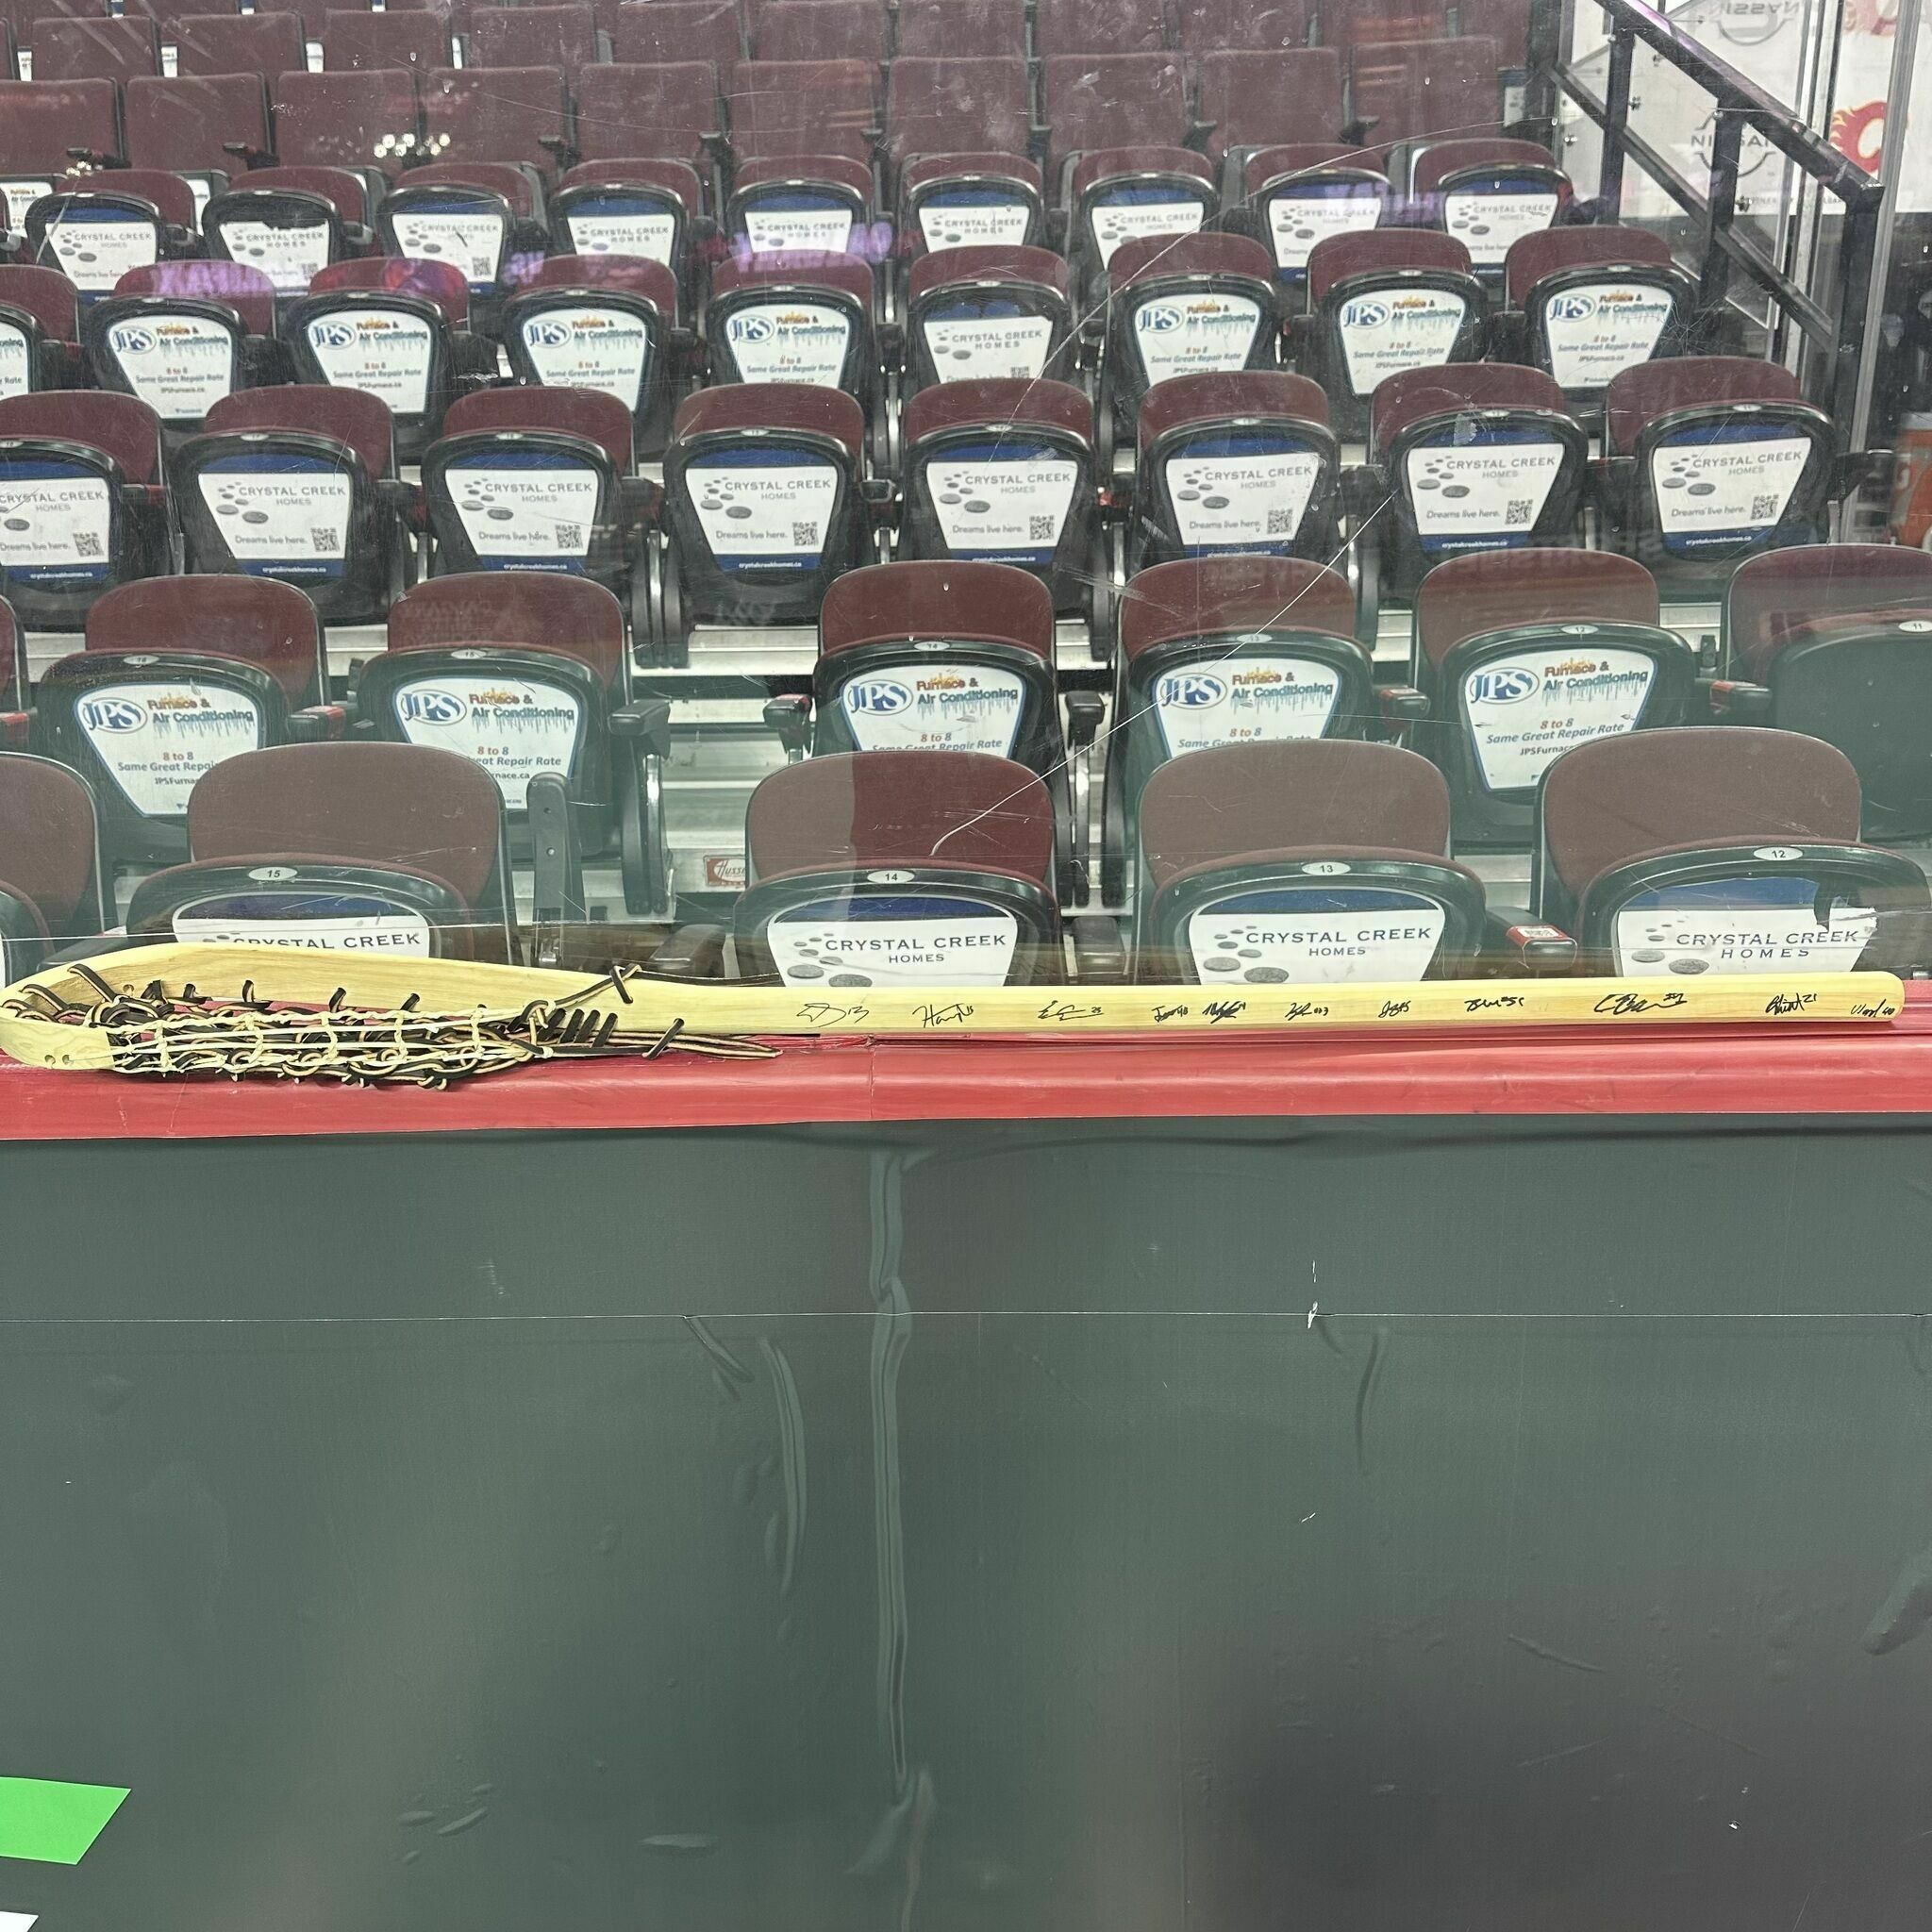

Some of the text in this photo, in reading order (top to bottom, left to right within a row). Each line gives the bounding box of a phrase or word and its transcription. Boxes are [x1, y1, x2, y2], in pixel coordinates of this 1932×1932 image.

[1549, 299, 1591, 321] JPS
[1140, 308, 1180, 331] JPS
[731, 318, 773, 341] JPS
[952, 330, 1041, 342] CRYSTAL CREEK
[975, 341, 1020, 349] HOMES
[1447, 458, 1555, 469] CRYSTAL CREEK
[1692, 451, 1801, 468] CRYSTAL CREEK
[1206, 467, 1311, 480] CRYSTAL CREEK
[1728, 466, 1764, 475] HOMES
[724, 479, 830, 491] CRYSTAL CREEK
[965, 474, 1070, 484] CRYSTAL CREEK
[1241, 480, 1275, 489] HOMES
[239, 487, 345, 495] CRYSTAL CREEK
[485, 483, 591, 492] CRYSTAL CREEK
[0, 491, 104, 505] CRYSTAL CREEK
[1426, 510, 1459, 519] Dreams
[1672, 508, 1707, 517] Dreams
[1190, 521, 1222, 529] Dreams
[478, 531, 511, 540] Dreams
[716, 530, 748, 539] Dreams
[1544, 661, 1609, 677] Furnace &
[916, 678, 978, 691] Furnace &
[1232, 673, 1294, 685] Furnace &
[1543, 671, 1648, 691] Air Conditioning
[1162, 677, 1220, 707] JPS
[1232, 683, 1333, 699] Air Conditioning
[1471, 674, 1533, 704] JPS
[470, 693, 533, 705] Furnace &
[851, 684, 907, 713] JPS
[918, 689, 1018, 705] Air Conditioning
[147, 699, 210, 709] Furnace &
[401, 692, 460, 721] JPS
[81, 700, 142, 730] JPS
[153, 709, 254, 724] Air Conditioning
[472, 707, 574, 720] Air Conditioning
[1541, 721, 1548, 729] 8
[1566, 718, 1574, 726] 8
[1230, 728, 1237, 737] 8
[1254, 727, 1261, 736] 8
[1487, 724, 1624, 743] Same Great Repair Rate
[977, 740, 1002, 748] Rate
[1178, 739, 1209, 748] Same
[188, 752, 193, 760] 8
[478, 746, 484, 755] 8
[118, 762, 147, 771] Same
[150, 762, 180, 772] Great
[497, 757, 532, 768] Repair
[536, 757, 561, 765] Rate
[344, 934, 420, 948] CREEK
[1246, 928, 1430, 943] CRYSTAL CREEK
[1676, 929, 1858, 945] CRYSTAL CREEK
[825, 935, 1006, 950] CRYSTAL CREEK
[1309, 947, 1365, 956] HOMES
[1722, 949, 1808, 958] HOMES
[889, 954, 944, 963] HOMES
